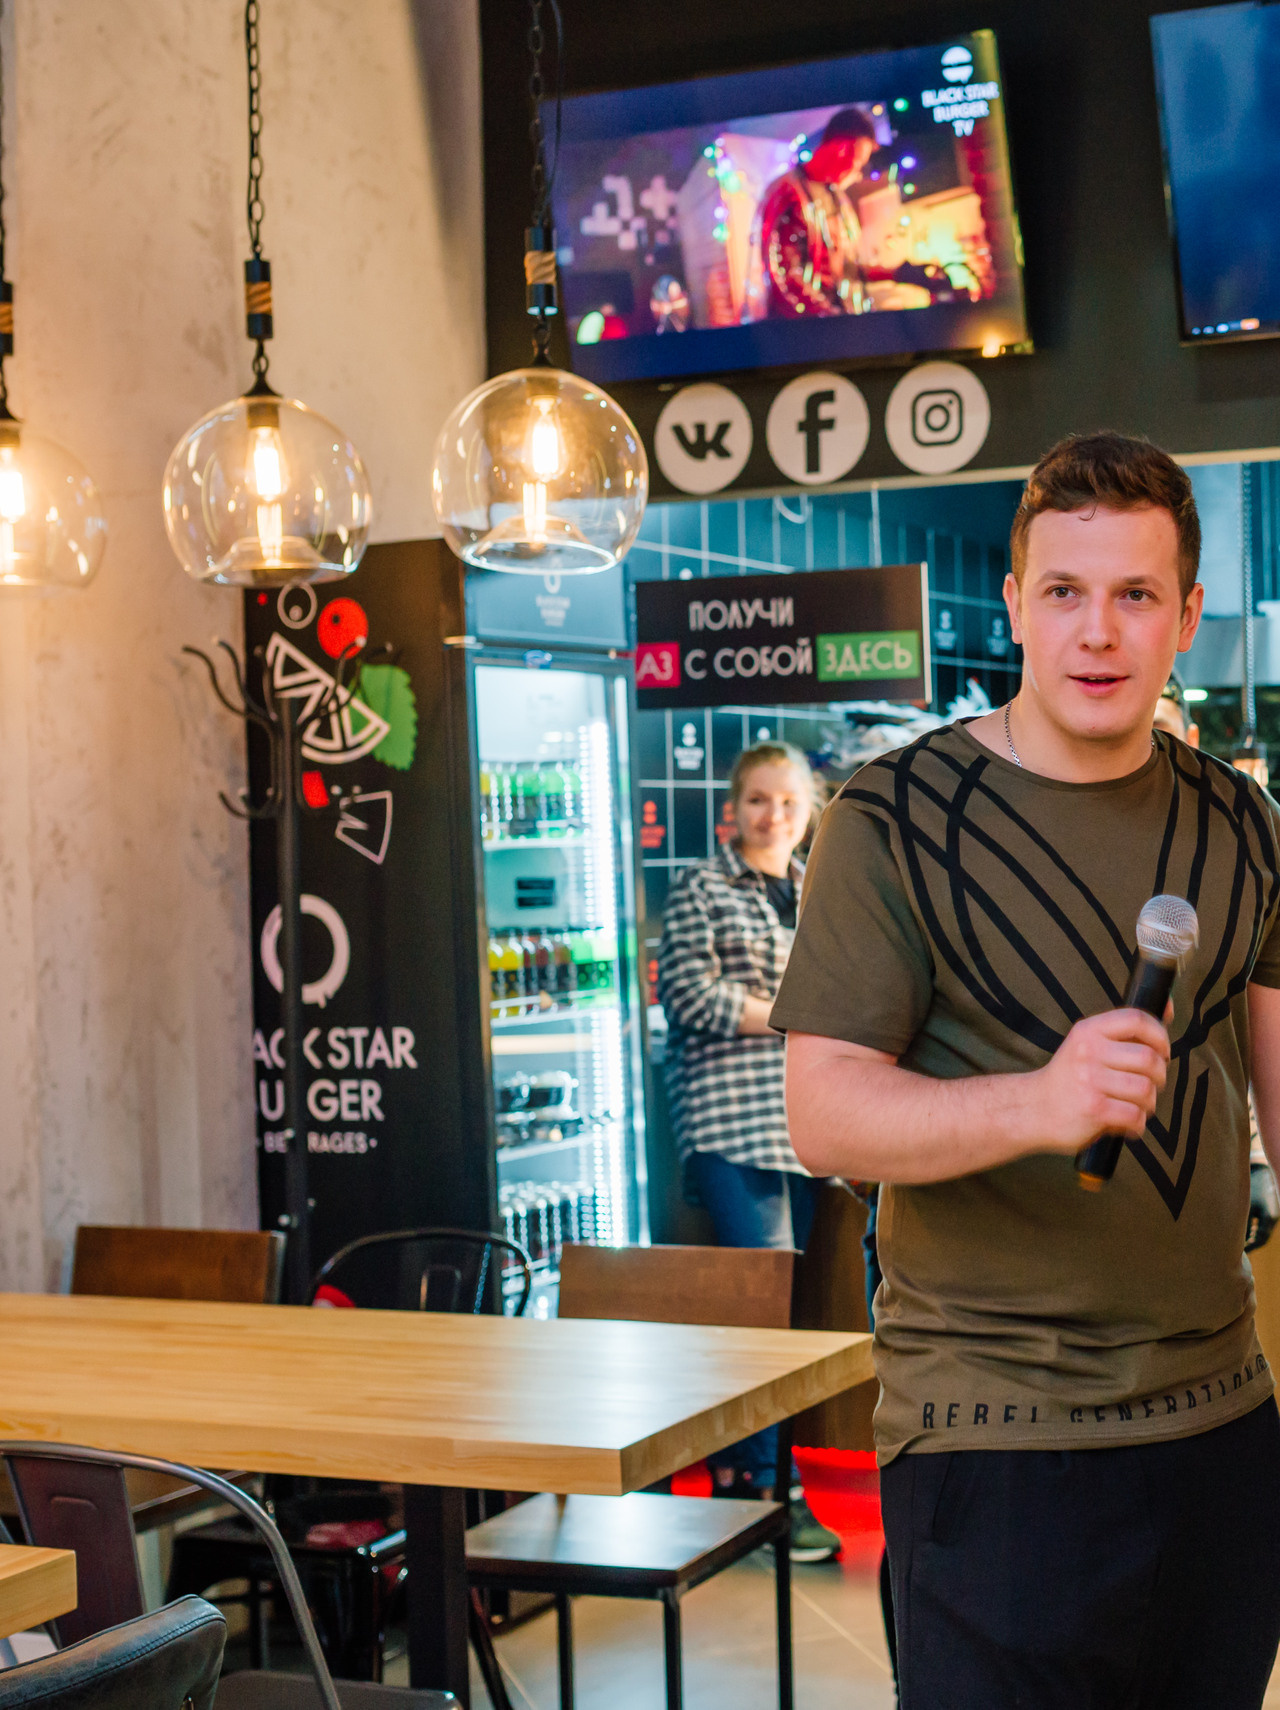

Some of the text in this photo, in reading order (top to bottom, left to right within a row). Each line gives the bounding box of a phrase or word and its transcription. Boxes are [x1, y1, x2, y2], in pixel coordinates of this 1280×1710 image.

[951, 119, 975, 137] TV
[688, 596, 794, 632] ПОЛУЧИ
[713, 636, 813, 679] СОБОЙ
[823, 641, 913, 677] ЗДЕСЬ
[327, 1026, 418, 1070] STAR
